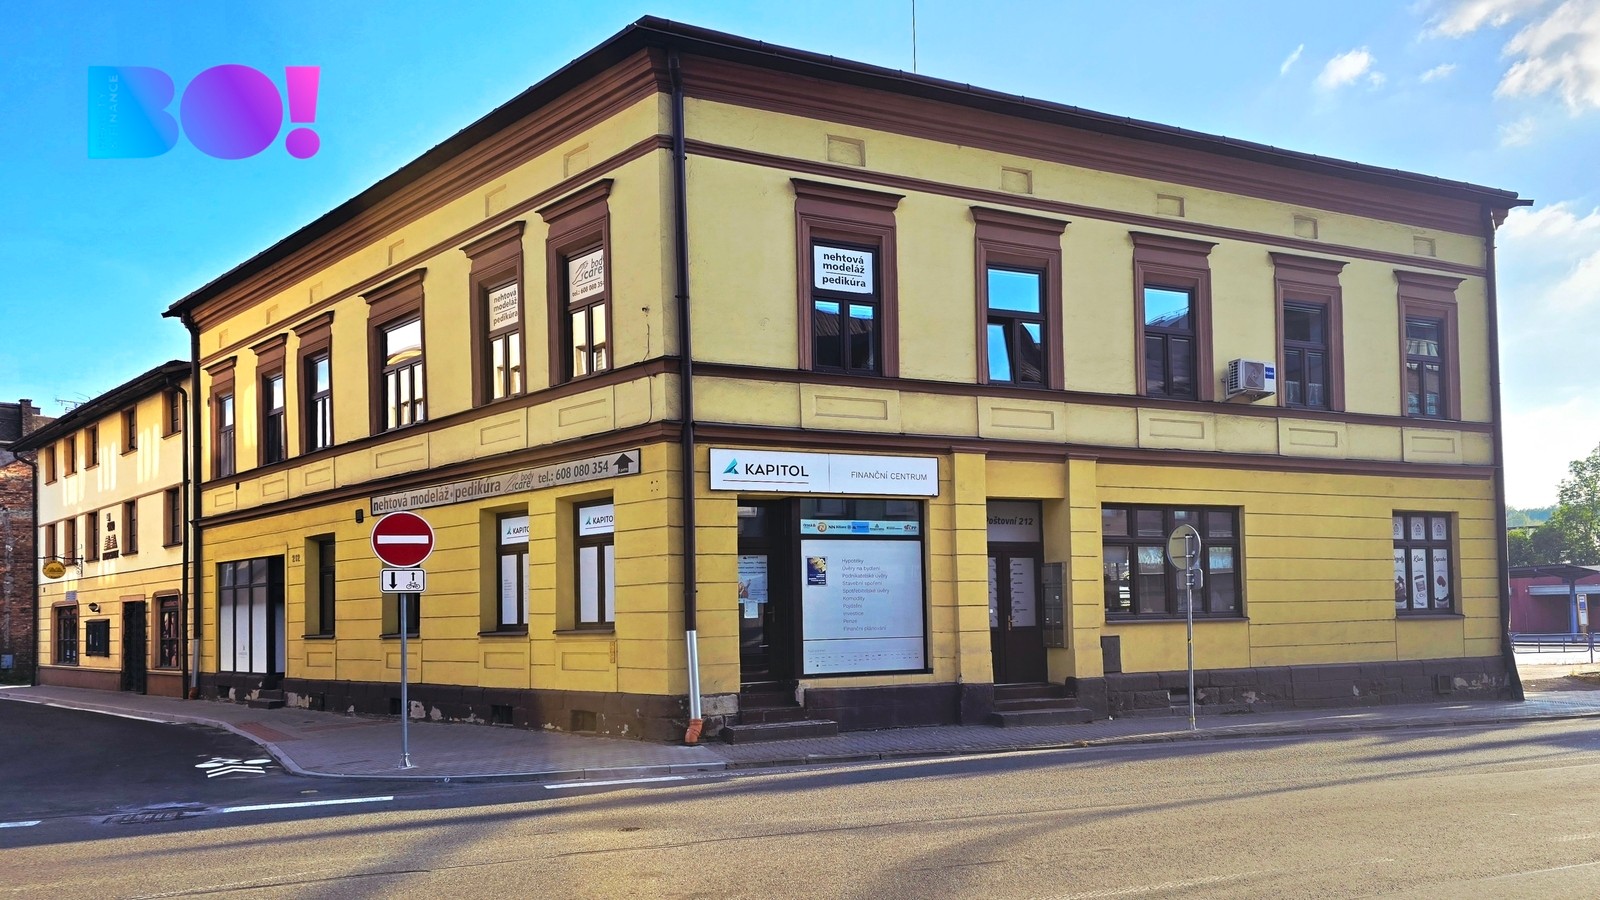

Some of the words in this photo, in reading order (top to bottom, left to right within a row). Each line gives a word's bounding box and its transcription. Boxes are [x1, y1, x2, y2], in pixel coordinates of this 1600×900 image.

[591, 255, 604, 269] bod
[823, 253, 864, 265] nehtová
[584, 265, 603, 279] care
[823, 262, 865, 274] modeláž
[822, 276, 866, 287] pedikúra
[493, 288, 517, 304] nehtová
[493, 297, 517, 313] modeláž
[493, 310, 518, 327] pedikúra
[555, 466, 571, 481] 608
[573, 463, 590, 477] 080
[592, 460, 609, 475] 354
[745, 463, 810, 477] KAPITOL
[520, 471, 534, 482] body
[538, 470, 554, 484] tel.:
[850, 470, 888, 480] FINANČNÍ
[890, 472, 928, 481] CENTRUM
[455, 477, 501, 502] pedikúra
[514, 480, 531, 490] care
[373, 493, 408, 511] nehtová
[410, 486, 450, 506] modeláž
[592, 515, 613, 525] KAPITO
[986, 515, 1018, 526] oštovní
[1018, 517, 1034, 526] 212
[512, 525, 529, 535] KAPITO
